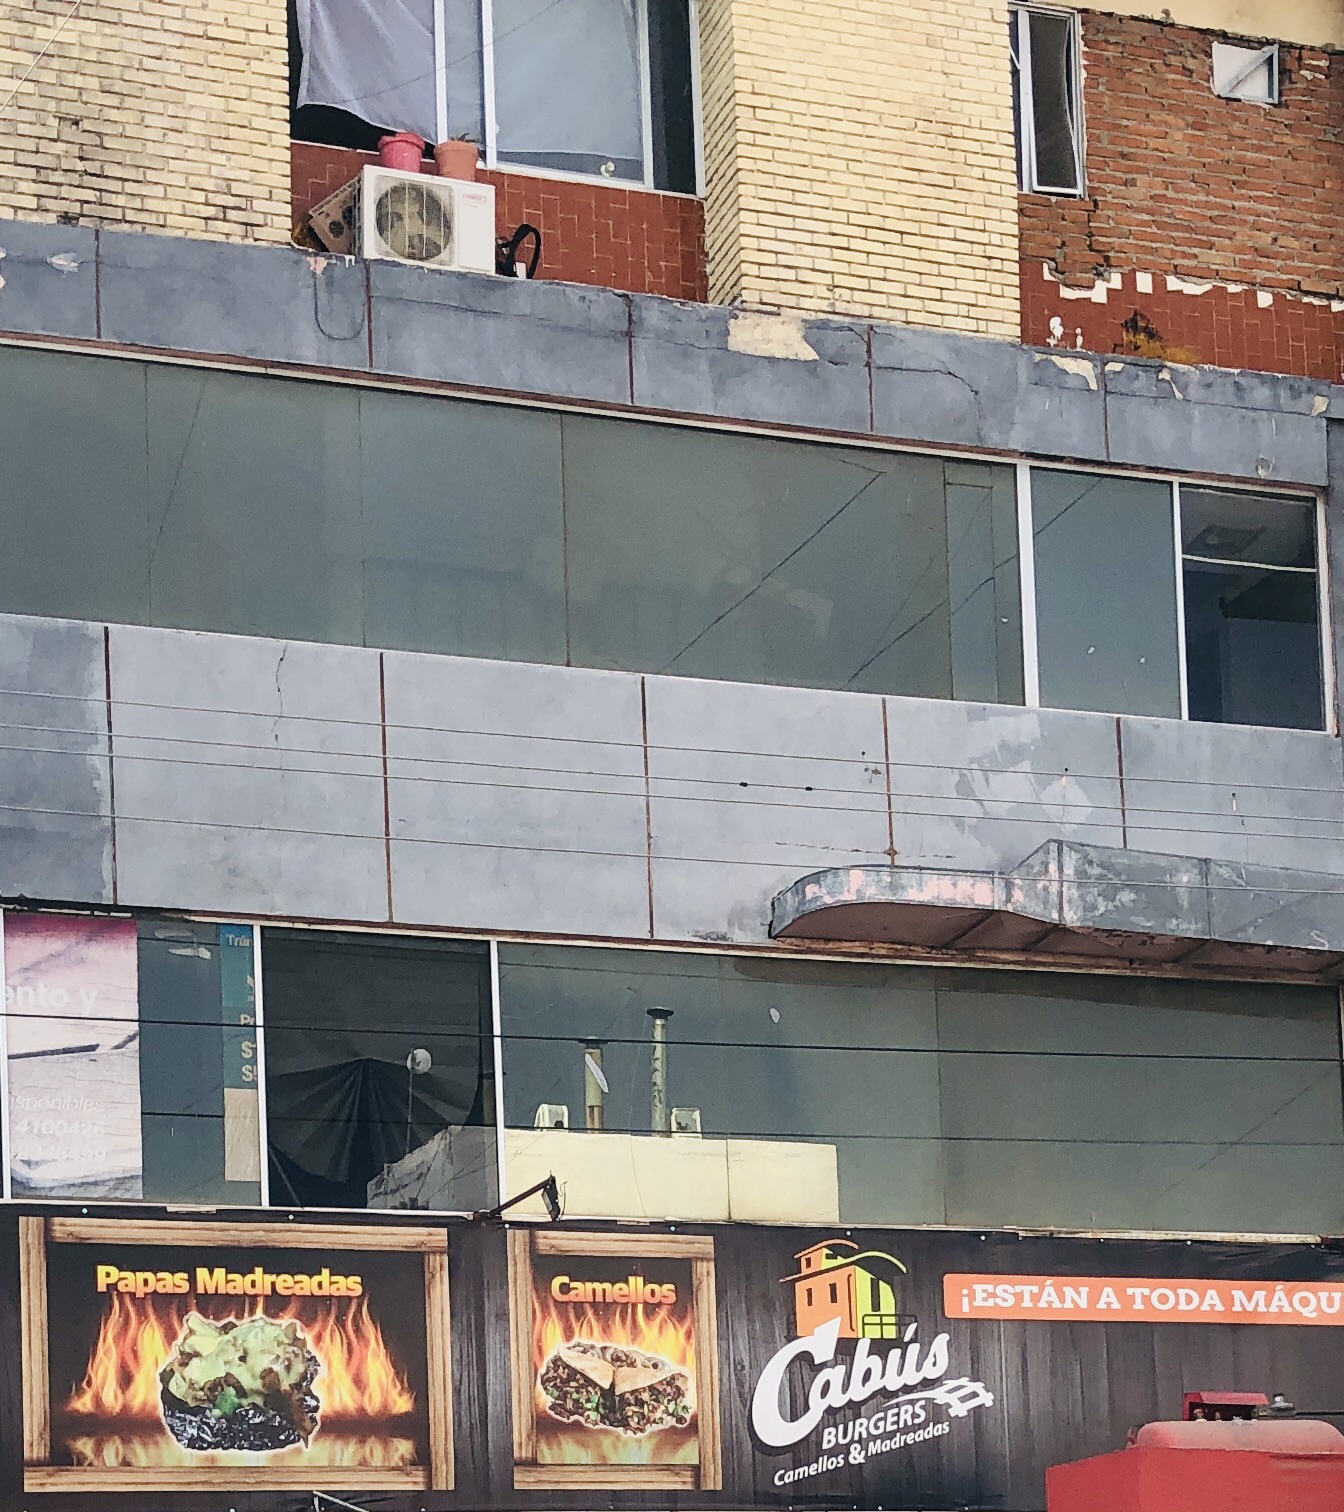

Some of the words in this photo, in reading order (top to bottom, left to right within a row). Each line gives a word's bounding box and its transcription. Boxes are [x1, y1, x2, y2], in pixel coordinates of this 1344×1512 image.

[80, 989, 97, 1016] y
[96, 1265, 190, 1298] Papas
[195, 1267, 363, 1297] Madreadas
[551, 1275, 677, 1304] Camellos
[961, 1280, 1090, 1313] ¡ESTÁN
[1097, 1287, 1122, 1309] A
[1126, 1287, 1225, 1312] TODA
[752, 1316, 951, 1448] Cabús
[821, 1400, 927, 1450] BURGERS
[773, 1453, 845, 1486] Camellos
[848, 1443, 866, 1465] &
[867, 1421, 950, 1457] Madreadas
